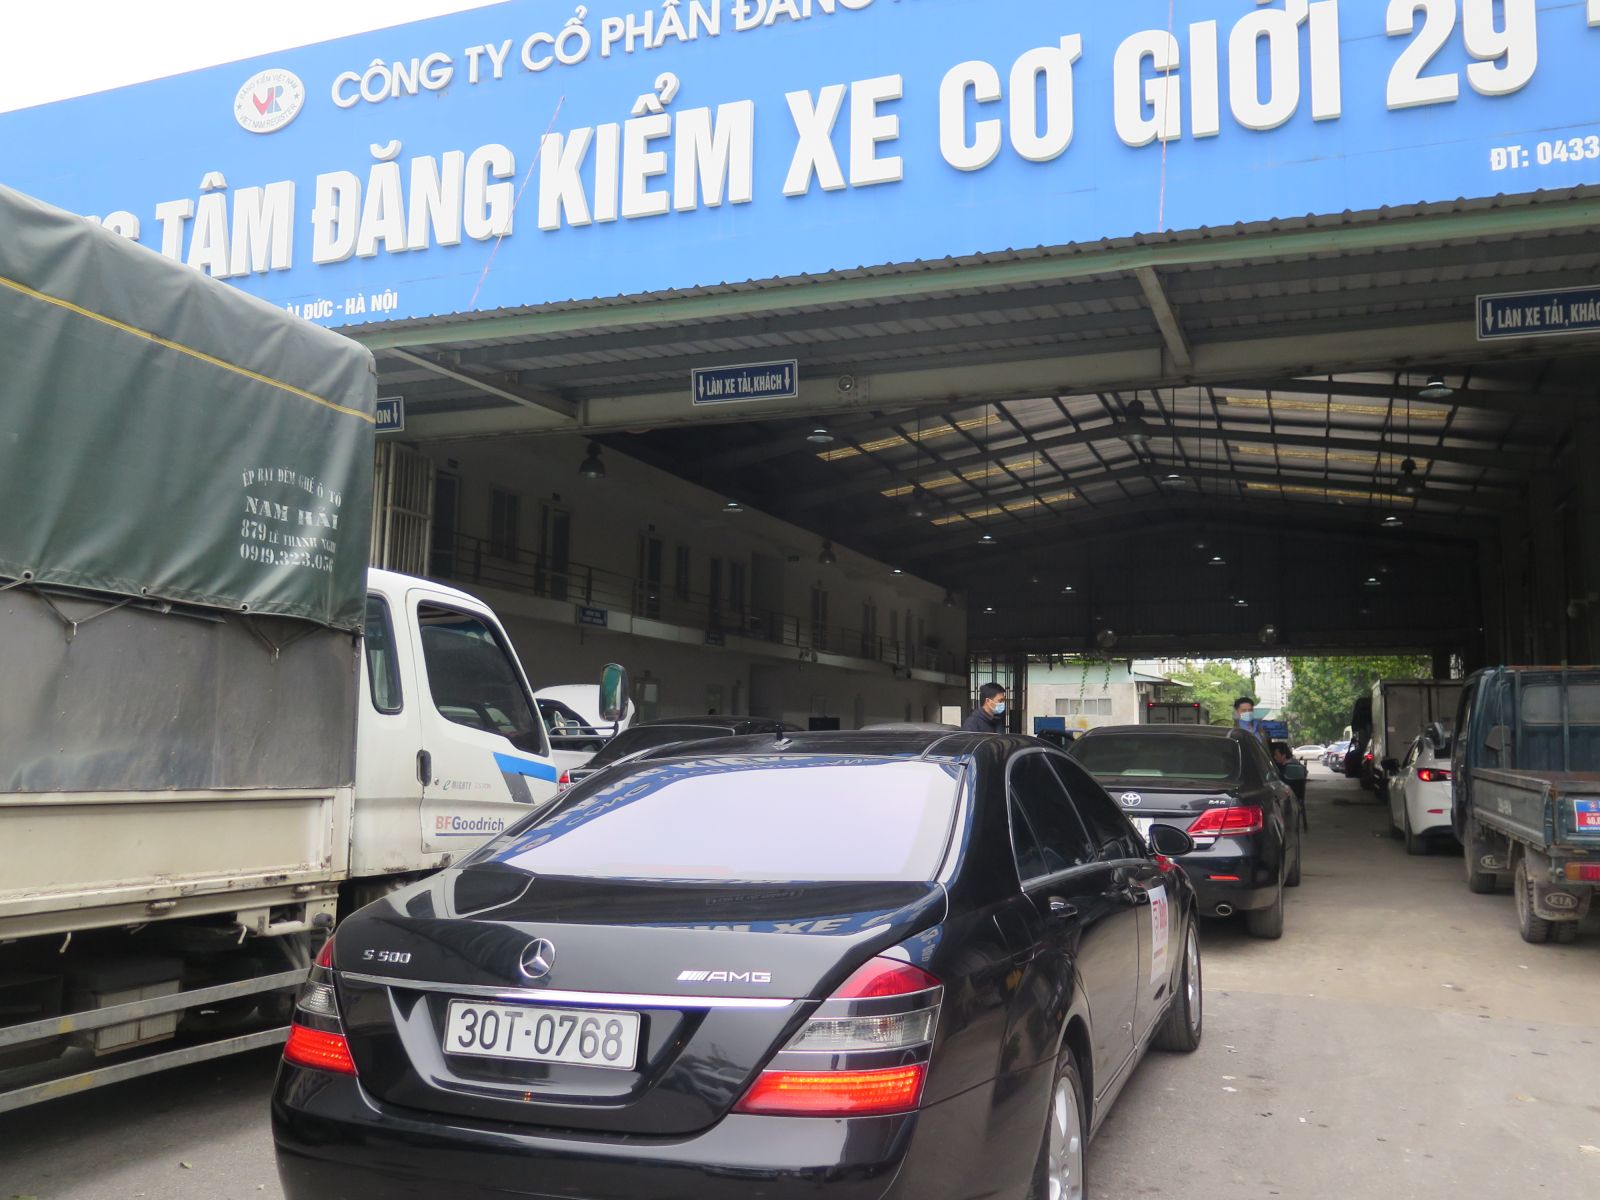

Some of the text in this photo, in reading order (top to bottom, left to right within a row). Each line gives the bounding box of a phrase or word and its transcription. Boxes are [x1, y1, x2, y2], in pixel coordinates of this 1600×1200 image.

[331, 53, 455, 109] CÔNG
[465, 39, 513, 85] TY
[521, 5, 592, 73] CỔ
[156, 171, 296, 280] TÂM
[312, 139, 515, 265] ĐĂNG
[537, 72, 755, 232] KIỂM
[782, 73, 904, 198] XE
[939, 33, 1083, 172] CƠ
[1386, 0, 1538, 111] 29
[1489, 135, 1600, 171] ĐT: 0433
[303, 298, 333, 321] ĐỨC
[345, 293, 366, 315] HÀ
[370, 288, 398, 314] NỘI
[1497, 306, 1522, 329] LÀN
[1525, 307, 1541, 327] XE
[706, 377, 723, 395] LÀN
[724, 377, 736, 394] XE
[245, 495, 289, 522] NAM
[241, 519, 267, 541] 879
[435, 815, 504, 831] BFGoodrich
[1549, 896, 1573, 906] KIA
[362, 949, 411, 964] S 500
[706, 970, 772, 983] AMG
